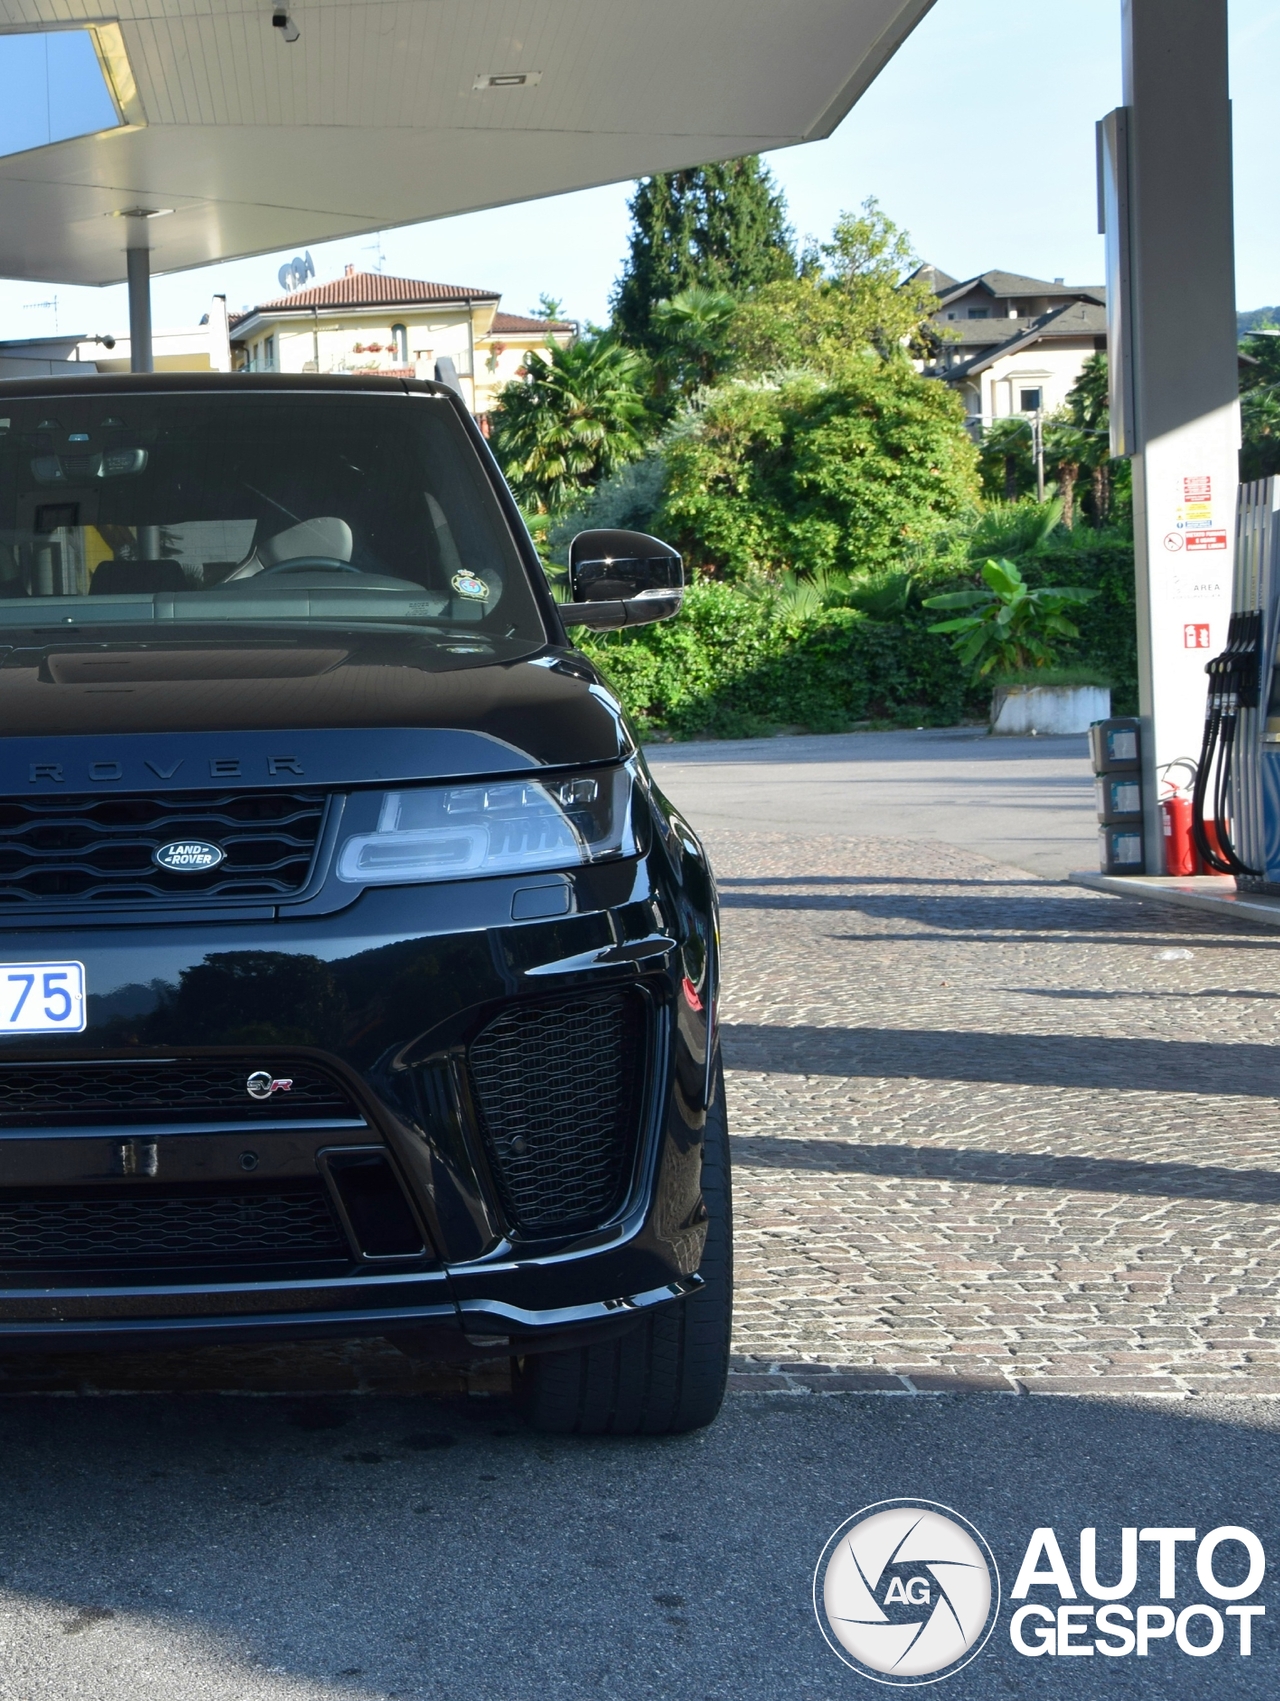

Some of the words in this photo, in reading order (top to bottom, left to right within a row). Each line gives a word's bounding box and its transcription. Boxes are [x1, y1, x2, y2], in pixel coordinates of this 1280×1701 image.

[1193, 583, 1221, 591] AREA
[28, 755, 305, 783] ROVER
[168, 845, 202, 855] LAND
[171, 854, 212, 864] ROVER
[246, 1076, 294, 1096] SVR
